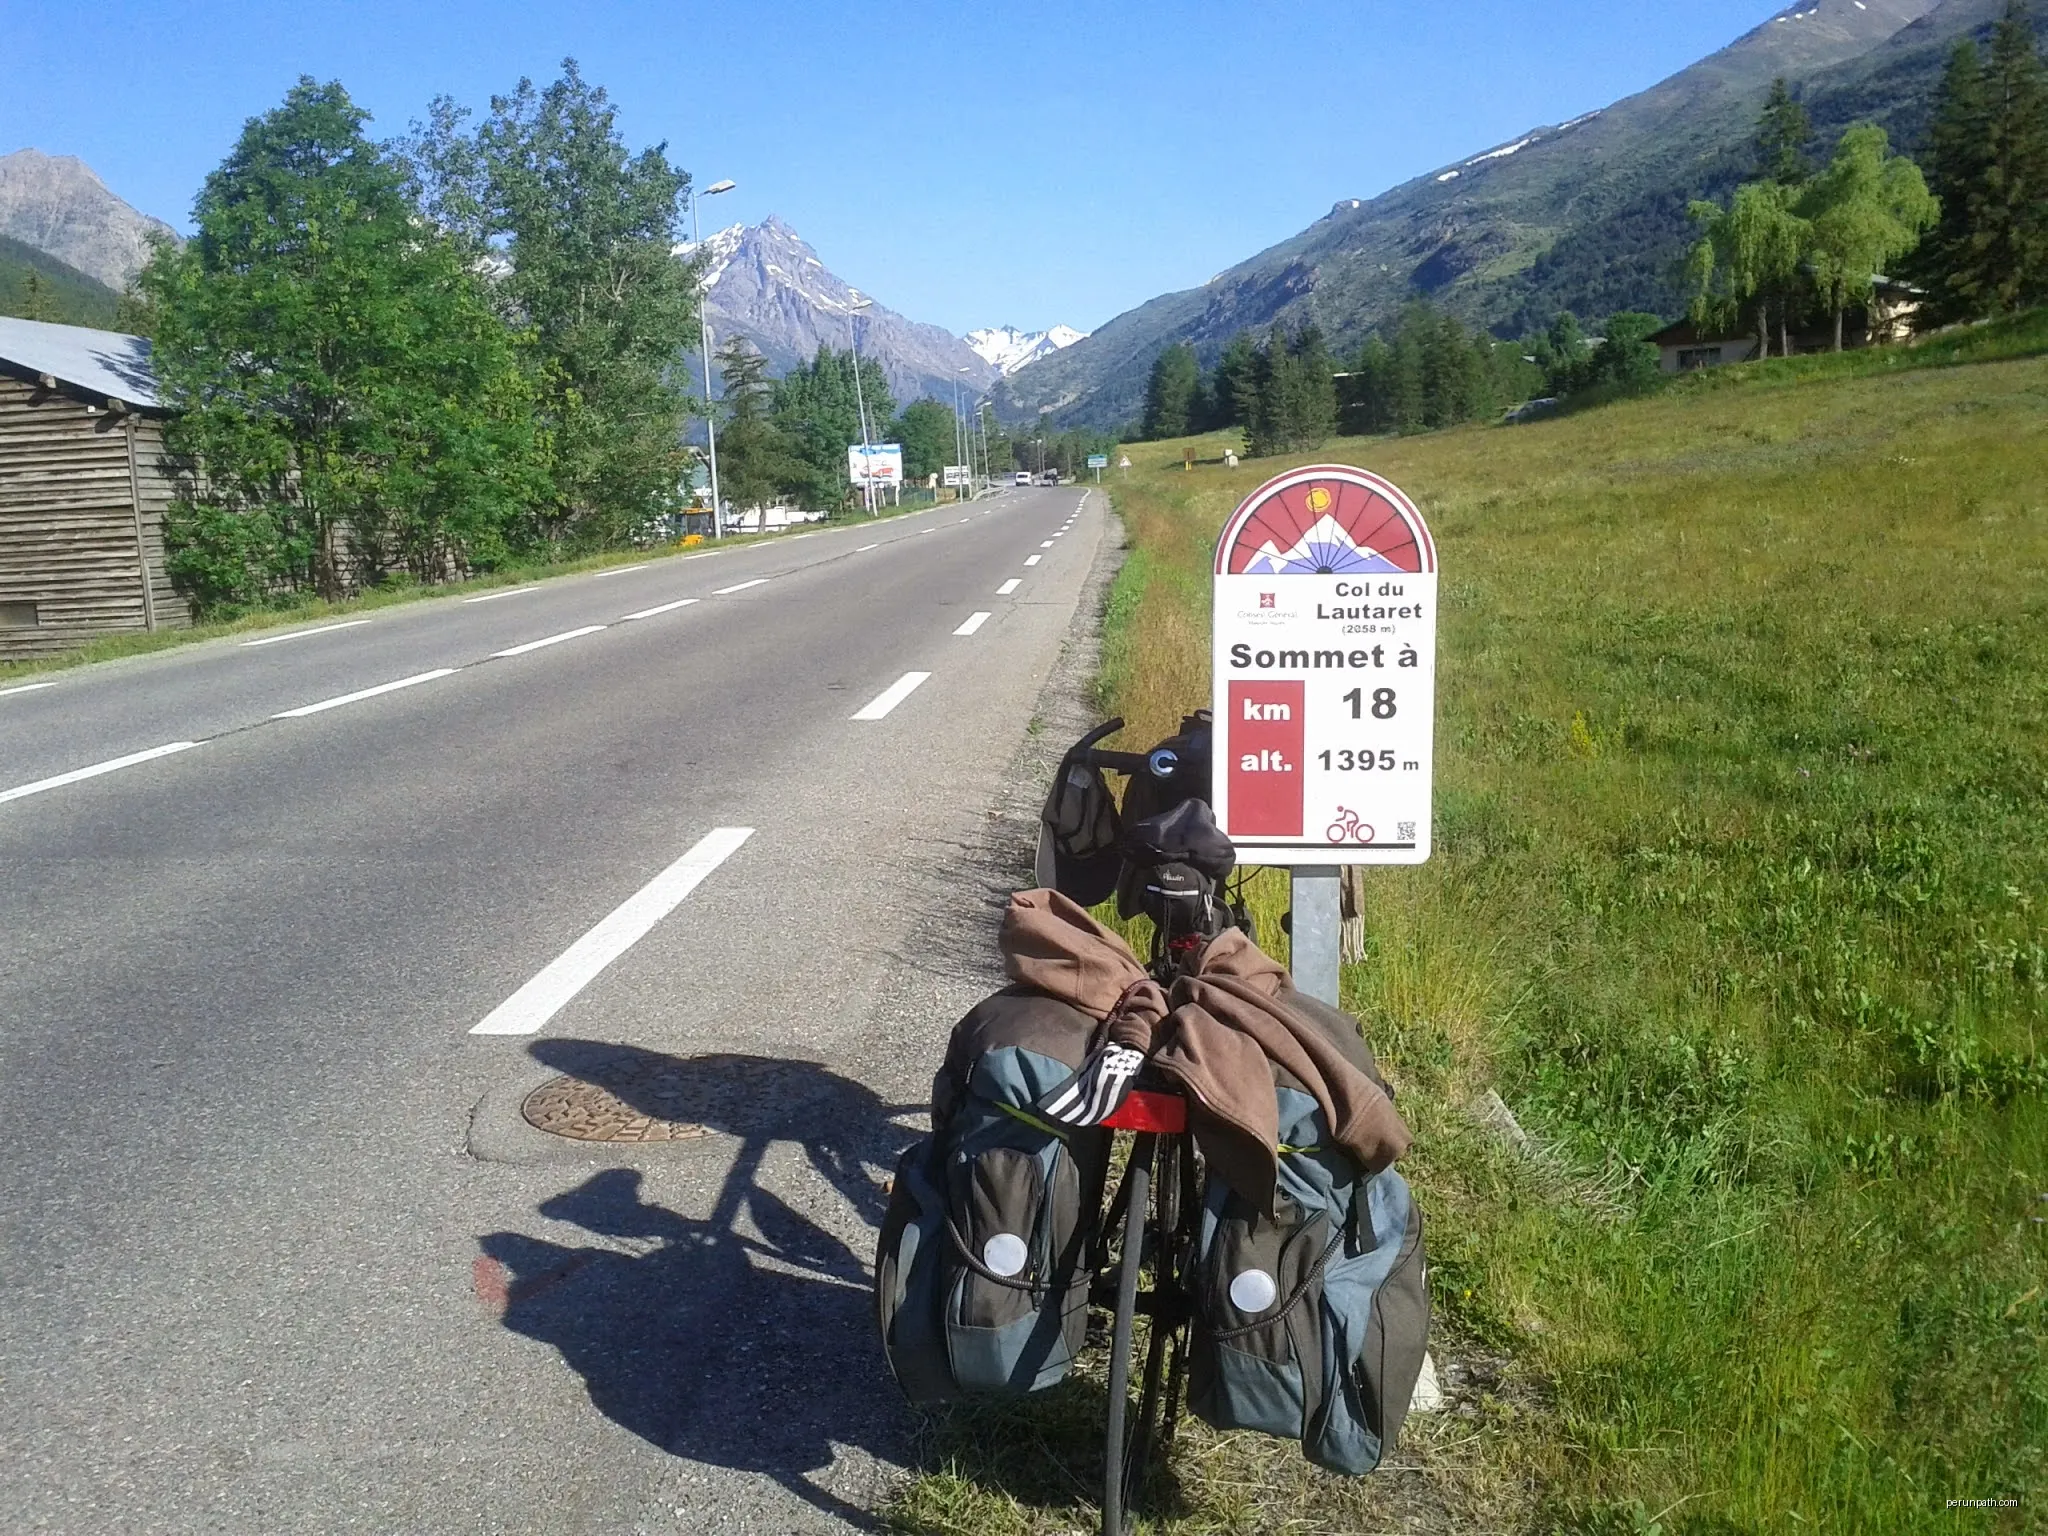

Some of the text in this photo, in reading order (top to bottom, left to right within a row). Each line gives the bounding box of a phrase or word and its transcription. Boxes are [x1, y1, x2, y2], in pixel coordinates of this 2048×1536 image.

[1335, 581, 1404, 597] Col du
[1316, 602, 1423, 620] Lautaret
[1341, 624, 1396, 636] (2058 m)
[1229, 642, 1418, 669] Sommet à
[1243, 687, 1397, 721] km 18
[1240, 749, 1419, 772] alt. 1395 m
